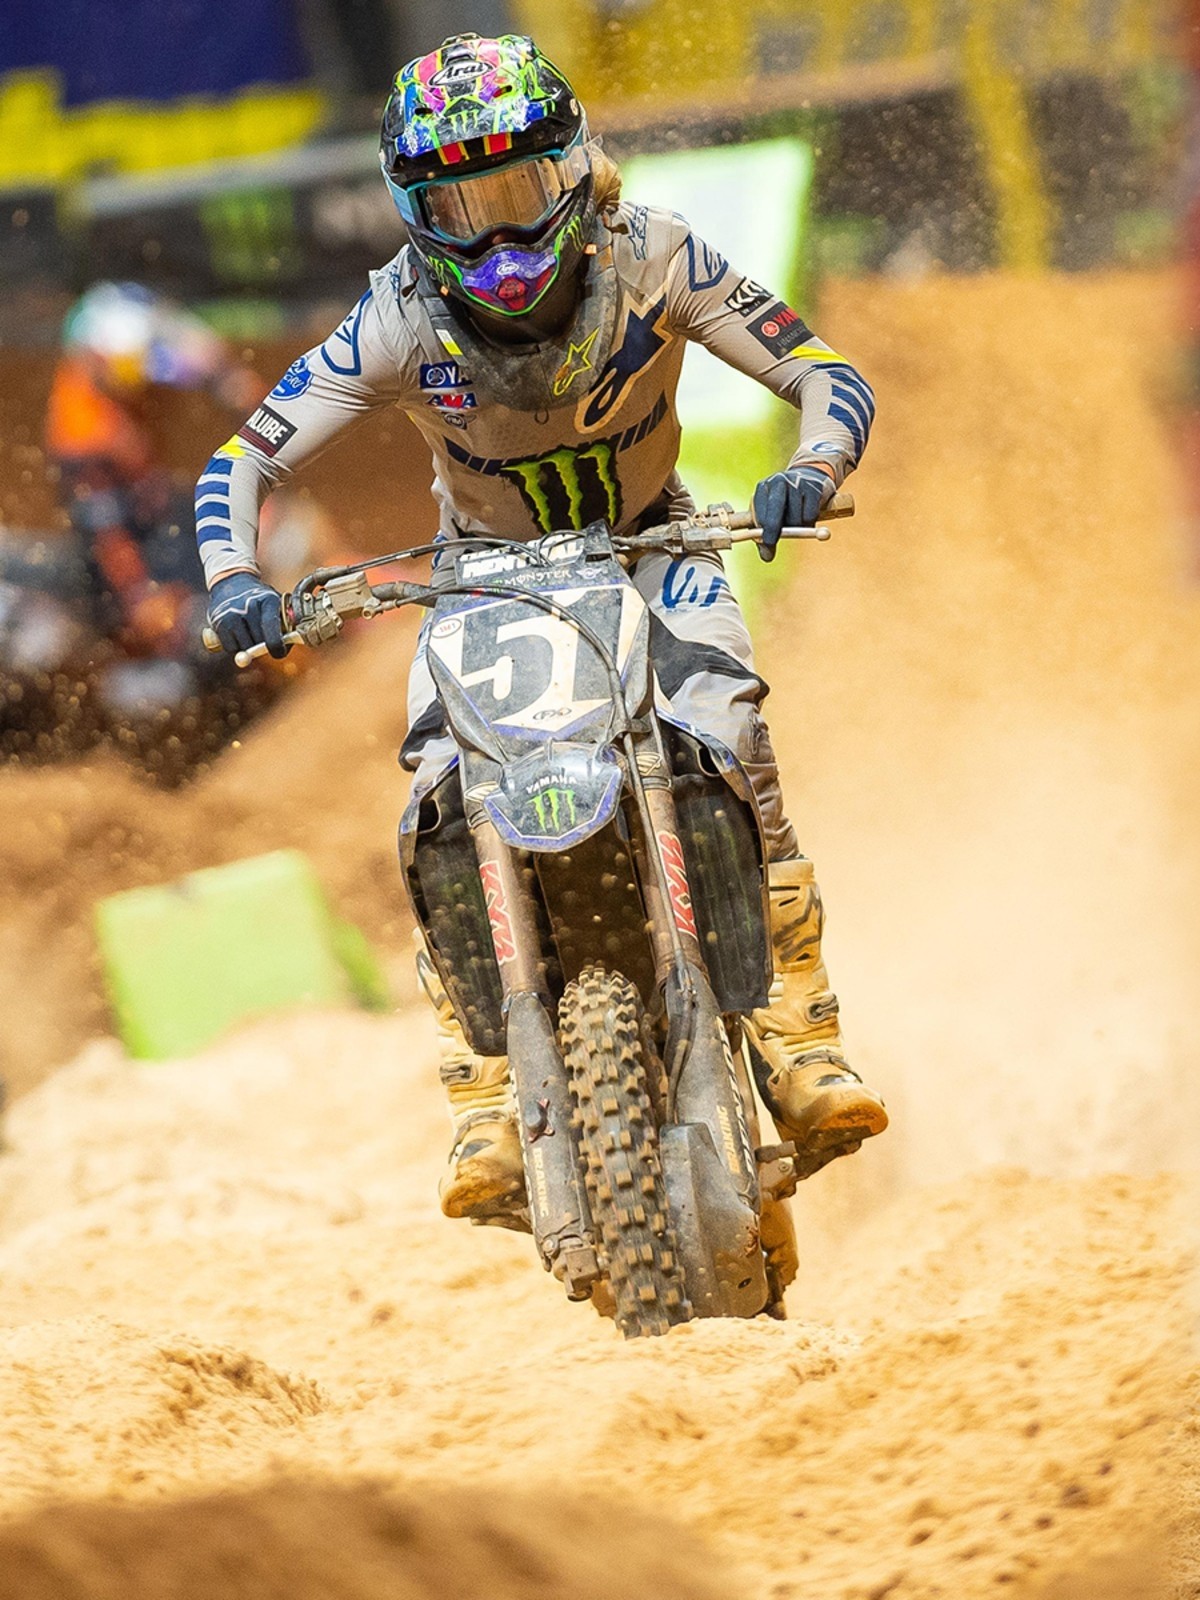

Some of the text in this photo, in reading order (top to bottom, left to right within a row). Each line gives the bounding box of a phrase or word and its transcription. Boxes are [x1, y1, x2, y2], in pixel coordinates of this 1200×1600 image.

[442, 60, 487, 80] Arai
[504, 567, 573, 587] MONSTER
[525, 774, 577, 794] YAMAHA
[715, 1104, 741, 1175] BRAKING
[532, 1146, 550, 1218] BRAKING
